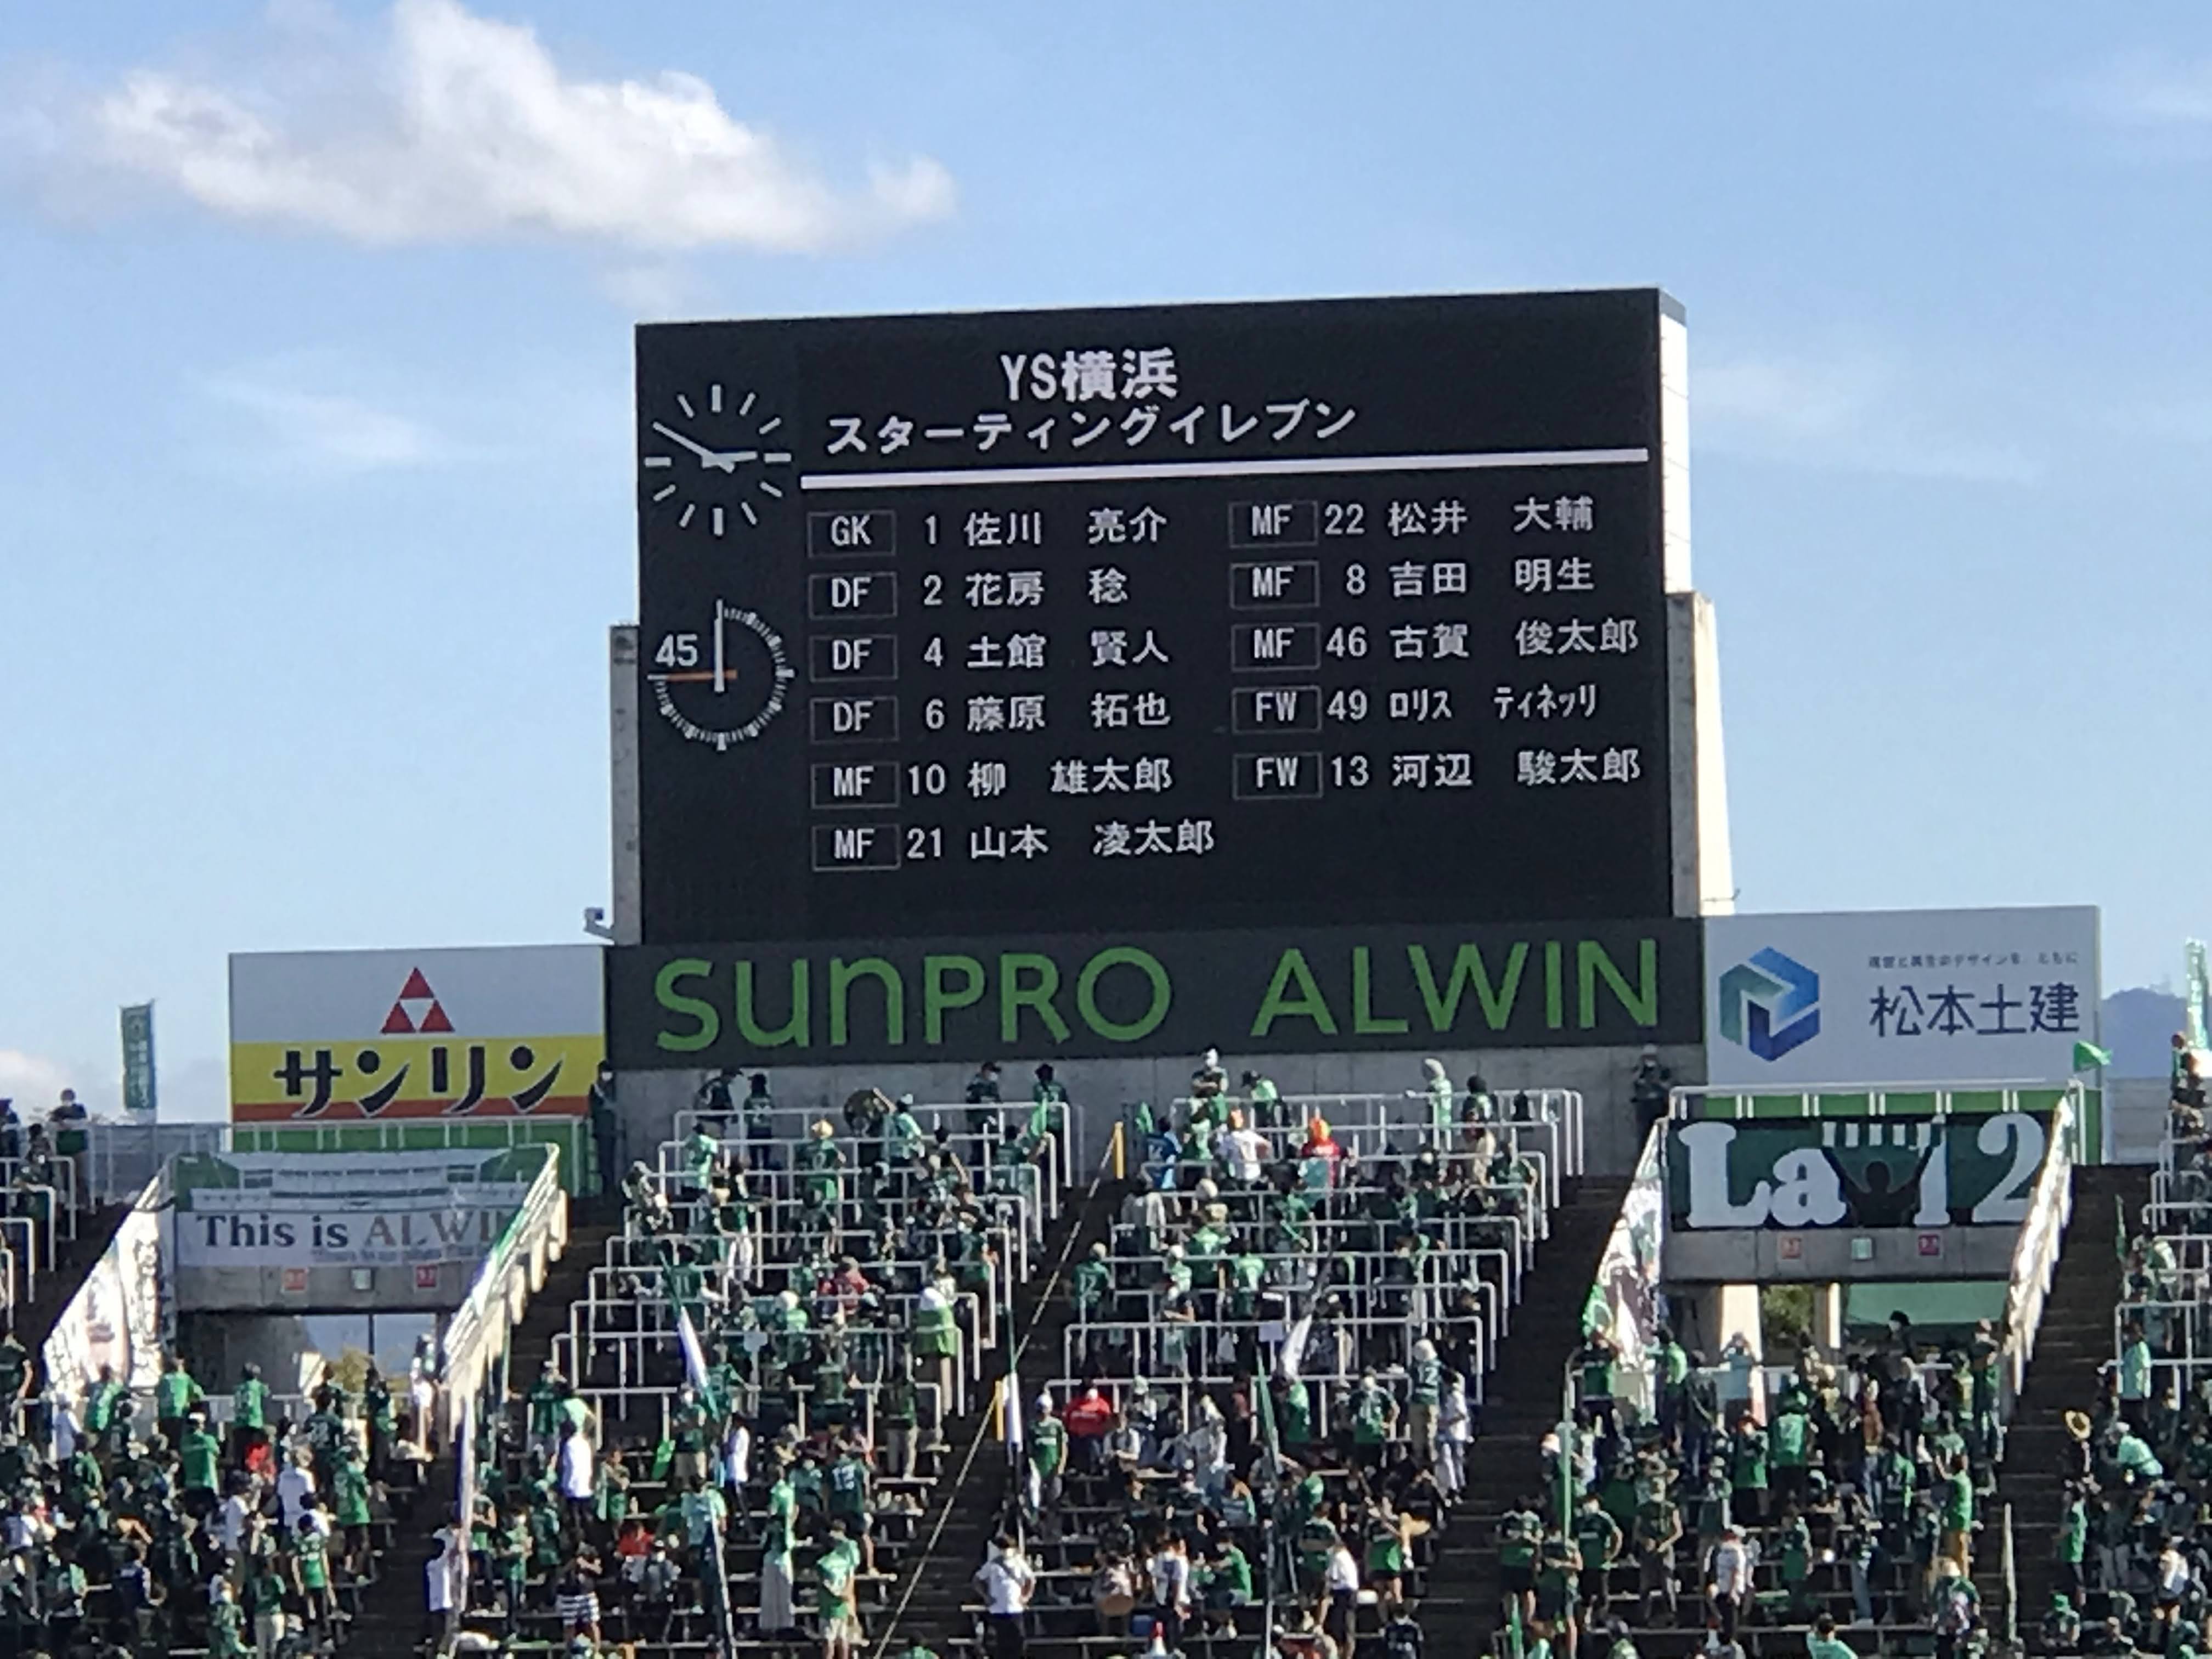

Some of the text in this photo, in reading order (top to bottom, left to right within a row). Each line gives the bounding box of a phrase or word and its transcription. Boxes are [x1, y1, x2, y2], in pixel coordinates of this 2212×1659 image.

[1000, 346, 1178, 403] YS横浜
[827, 398, 1356, 454] スターティングイレブン
[831, 506, 1167, 547] GK 1 佐川 亮介
[1251, 495, 1593, 537] MF 22 松井 大輔
[831, 567, 1128, 608] DF 2 花房 稔
[1252, 556, 1594, 598] MF 8 吉田 明生
[654, 633, 699, 668] 45
[832, 629, 1169, 670] DF 4 土館 賢人
[1254, 617, 1639, 659] MF 46 古賀 俊太郎
[833, 691, 1171, 732] DF 6 藤原 拓也
[1256, 691, 1297, 722] FW
[1327, 689, 1368, 720] 49
[833, 757, 1172, 798] MF 10 柳 雄太郎
[1256, 747, 1641, 788] FW 13 河辺 駿太郎
[834, 828, 875, 859] MF
[907, 827, 941, 859] 21
[970, 823, 1049, 859] 山本
[1250, 939, 1658, 1036] ALWIN
[1869, 981, 2081, 1037] 松本土建
[273, 1044, 566, 1118] サンリン
[1678, 1121, 1848, 1227] La
[196, 1212, 296, 1248] This
[311, 1214, 349, 1249] is
[1418, 1366, 1438, 1387] 12
